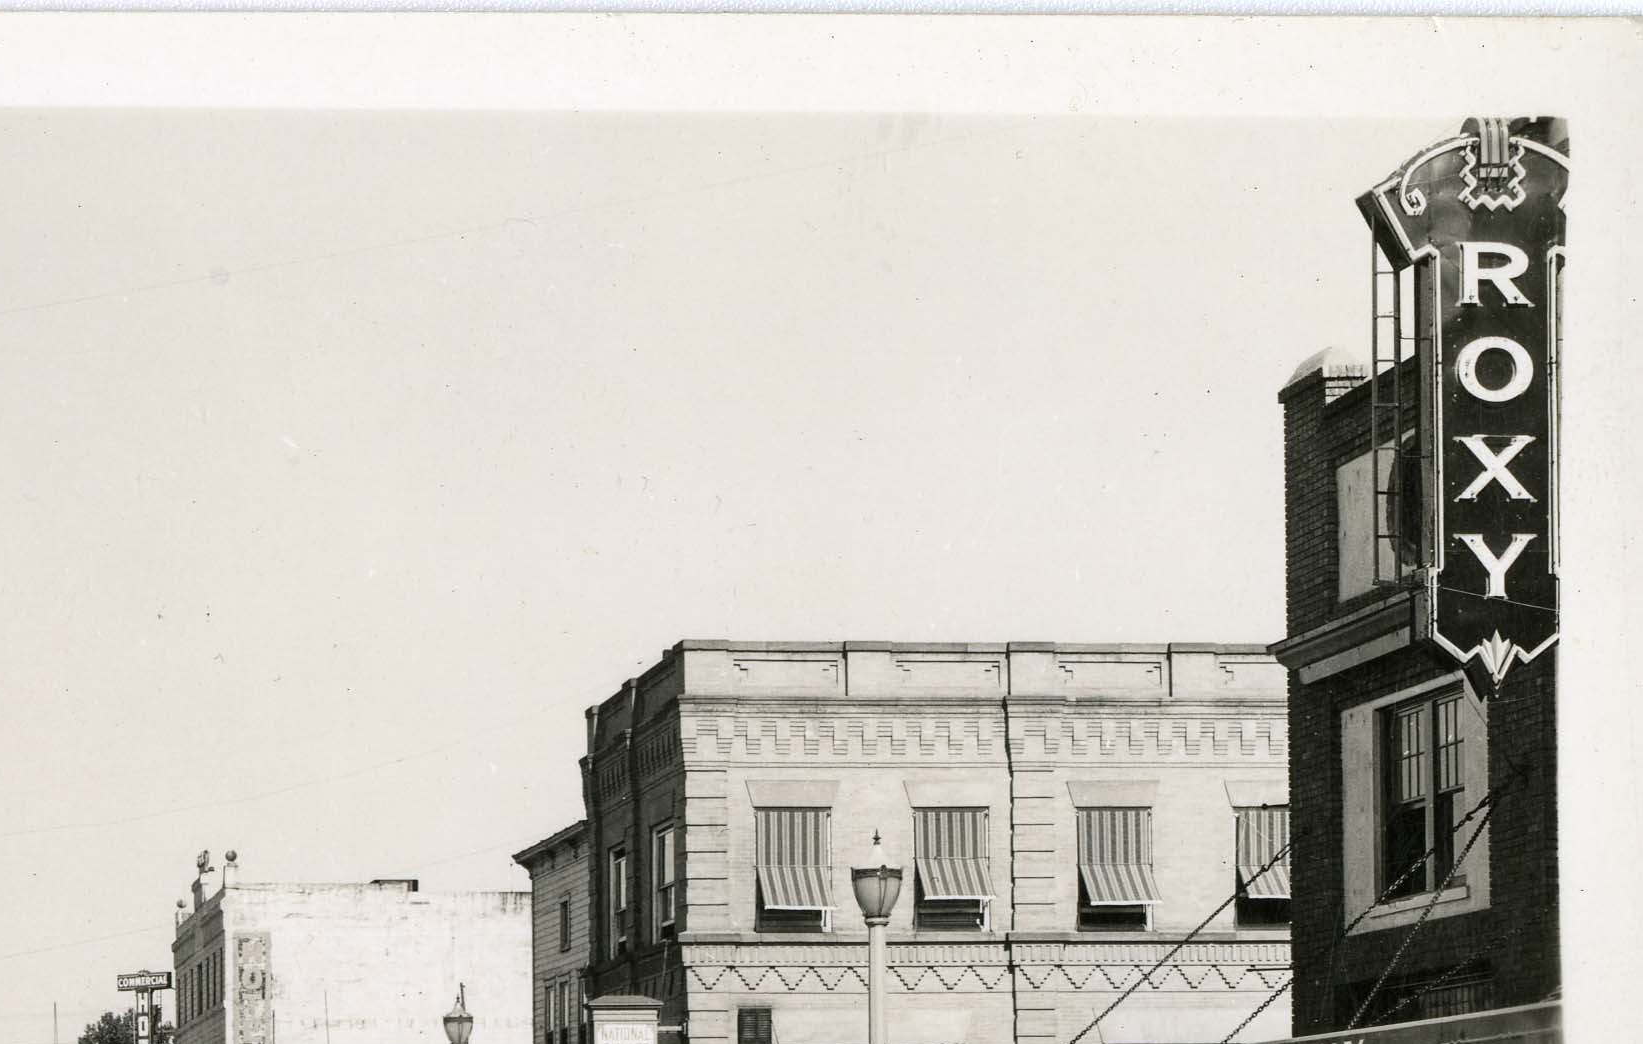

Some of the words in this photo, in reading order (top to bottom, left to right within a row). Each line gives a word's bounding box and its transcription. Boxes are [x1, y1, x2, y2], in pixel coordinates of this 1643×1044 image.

[1455, 241, 1537, 600] ROXY
[118, 976, 167, 987] COMMERCIAL
[601, 1027, 652, 1041] NATIONAL
